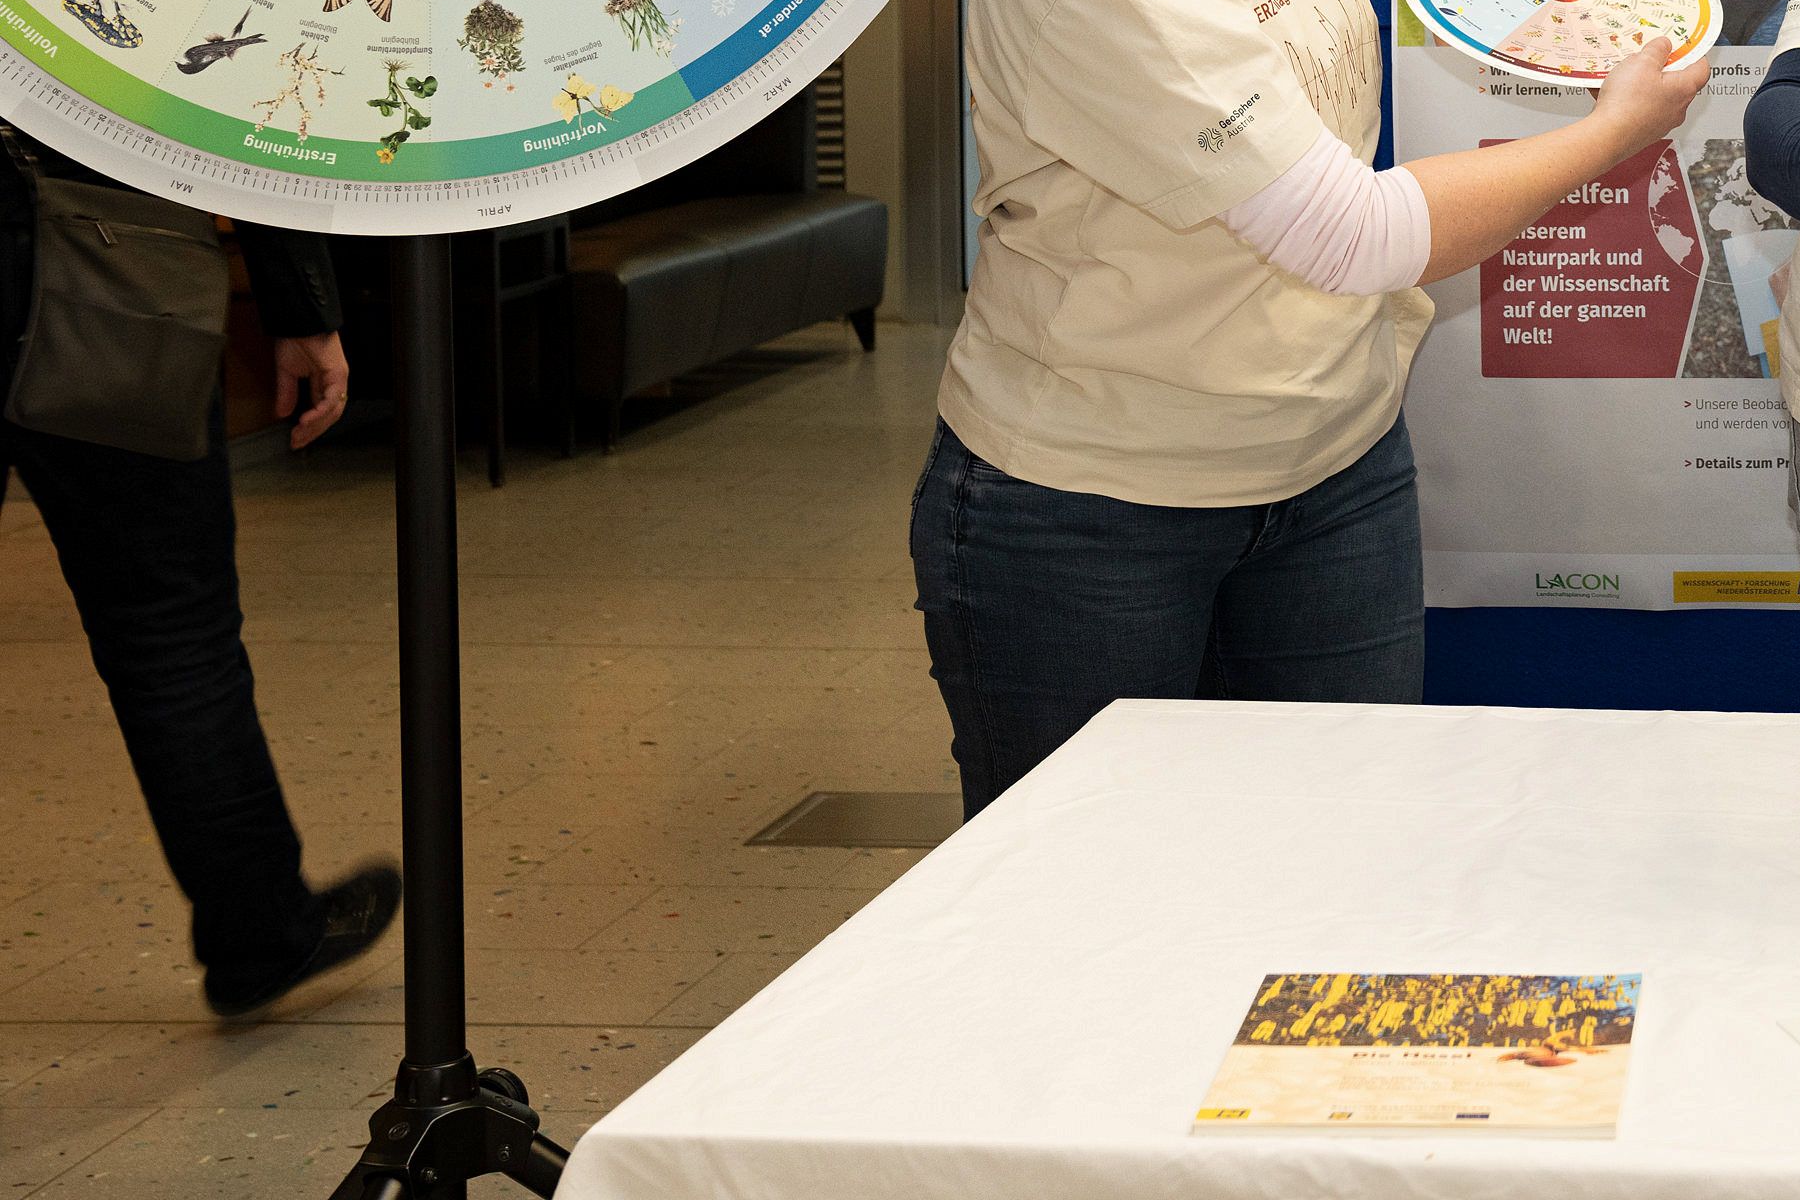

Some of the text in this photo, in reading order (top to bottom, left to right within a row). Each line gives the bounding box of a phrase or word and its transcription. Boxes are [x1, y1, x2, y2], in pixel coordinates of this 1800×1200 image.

[0, 1, 58, 58] Vollfrühli
[300, 29, 329, 42] Schlehe
[367, 45, 433, 54] Sumpfdotterblume
[553, 52, 599, 72] Zitronenfalter
[763, 76, 792, 102] MÄRZ
[1490, 85, 1512, 96] Wir
[1516, 84, 1561, 99] lernen,
[1219, 92, 1260, 130] GeoSphere
[1227, 114, 1255, 140] Austria
[523, 122, 607, 153] Vorfrühling
[243, 134, 336, 164] Erstfrühling
[170, 180, 194, 194] MAI
[1560, 182, 1629, 204] elfen
[477, 203, 512, 216] APRIL
[1503, 248, 1643, 270] Naturpark und
[1503, 274, 1670, 292] der Wissenschaft
[1503, 301, 1646, 322] auf der ganzen
[1503, 327, 1553, 345] Welt!
[1696, 398, 1788, 410] Unsere Beobac
[1696, 419, 1719, 430] und
[1723, 419, 1768, 430] werden
[1696, 457, 1742, 469] Details
[1746, 460, 1772, 469] zum
[1536, 573, 1620, 591] LACON
